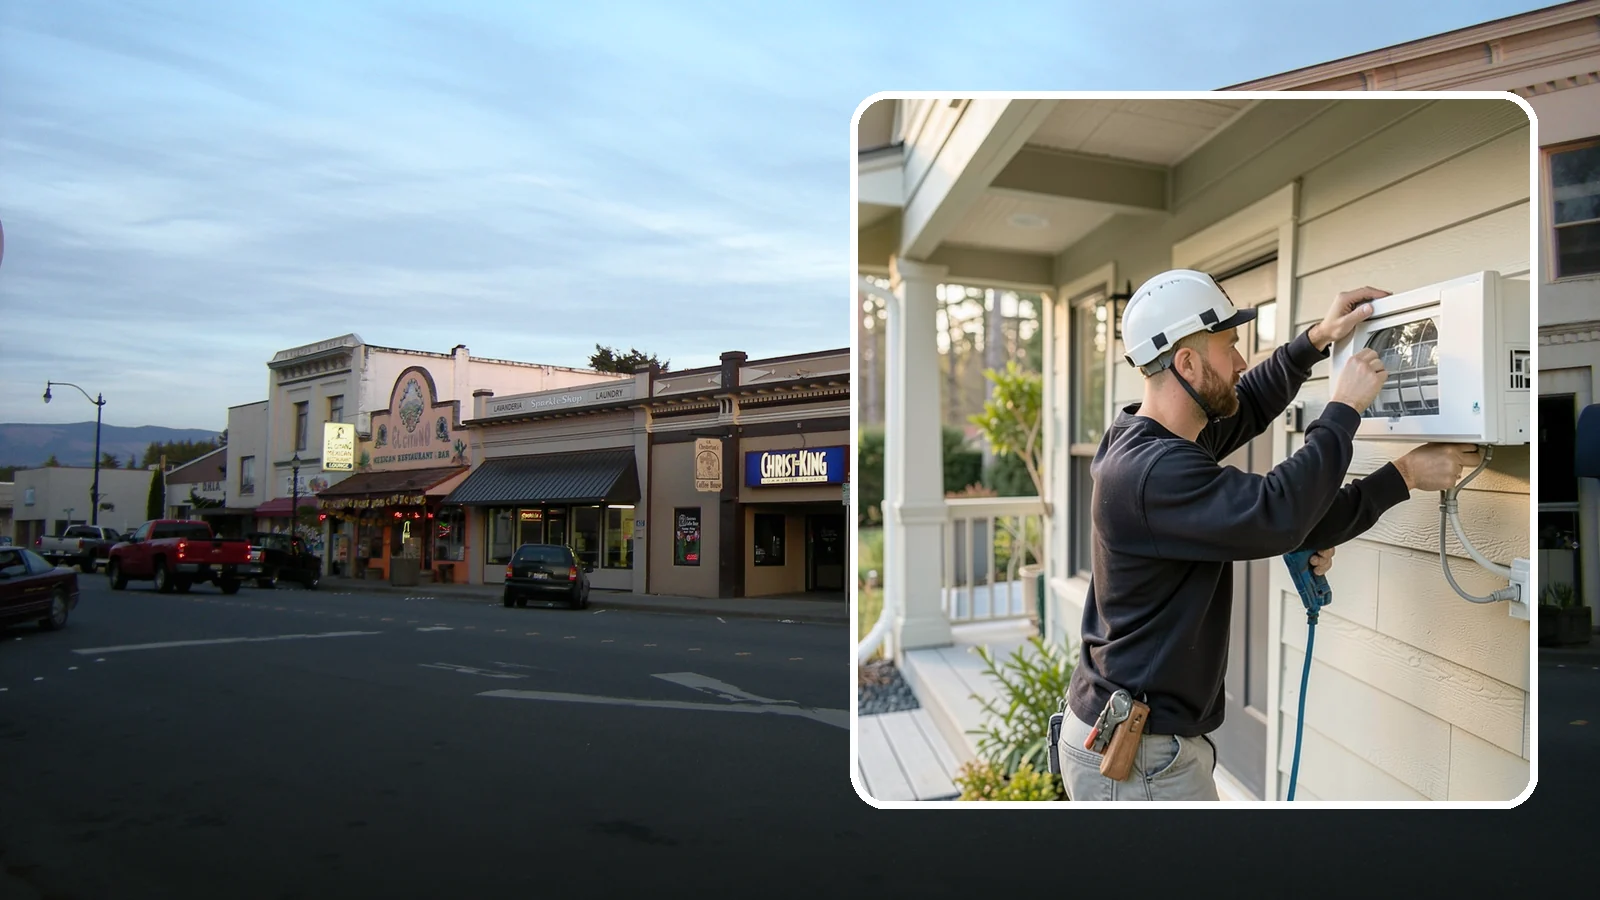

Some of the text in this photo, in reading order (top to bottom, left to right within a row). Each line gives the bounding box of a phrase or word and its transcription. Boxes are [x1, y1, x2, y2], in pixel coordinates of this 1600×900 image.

[596, 388, 623, 400] LAUNDRY
[492, 401, 522, 413] LAVANDERIA
[530, 393, 583, 410] Sparkle Shop
[374, 454, 396, 464] MEXICAN
[397, 451, 434, 462] RESTAURANT
[437, 450, 450, 459] BAR
